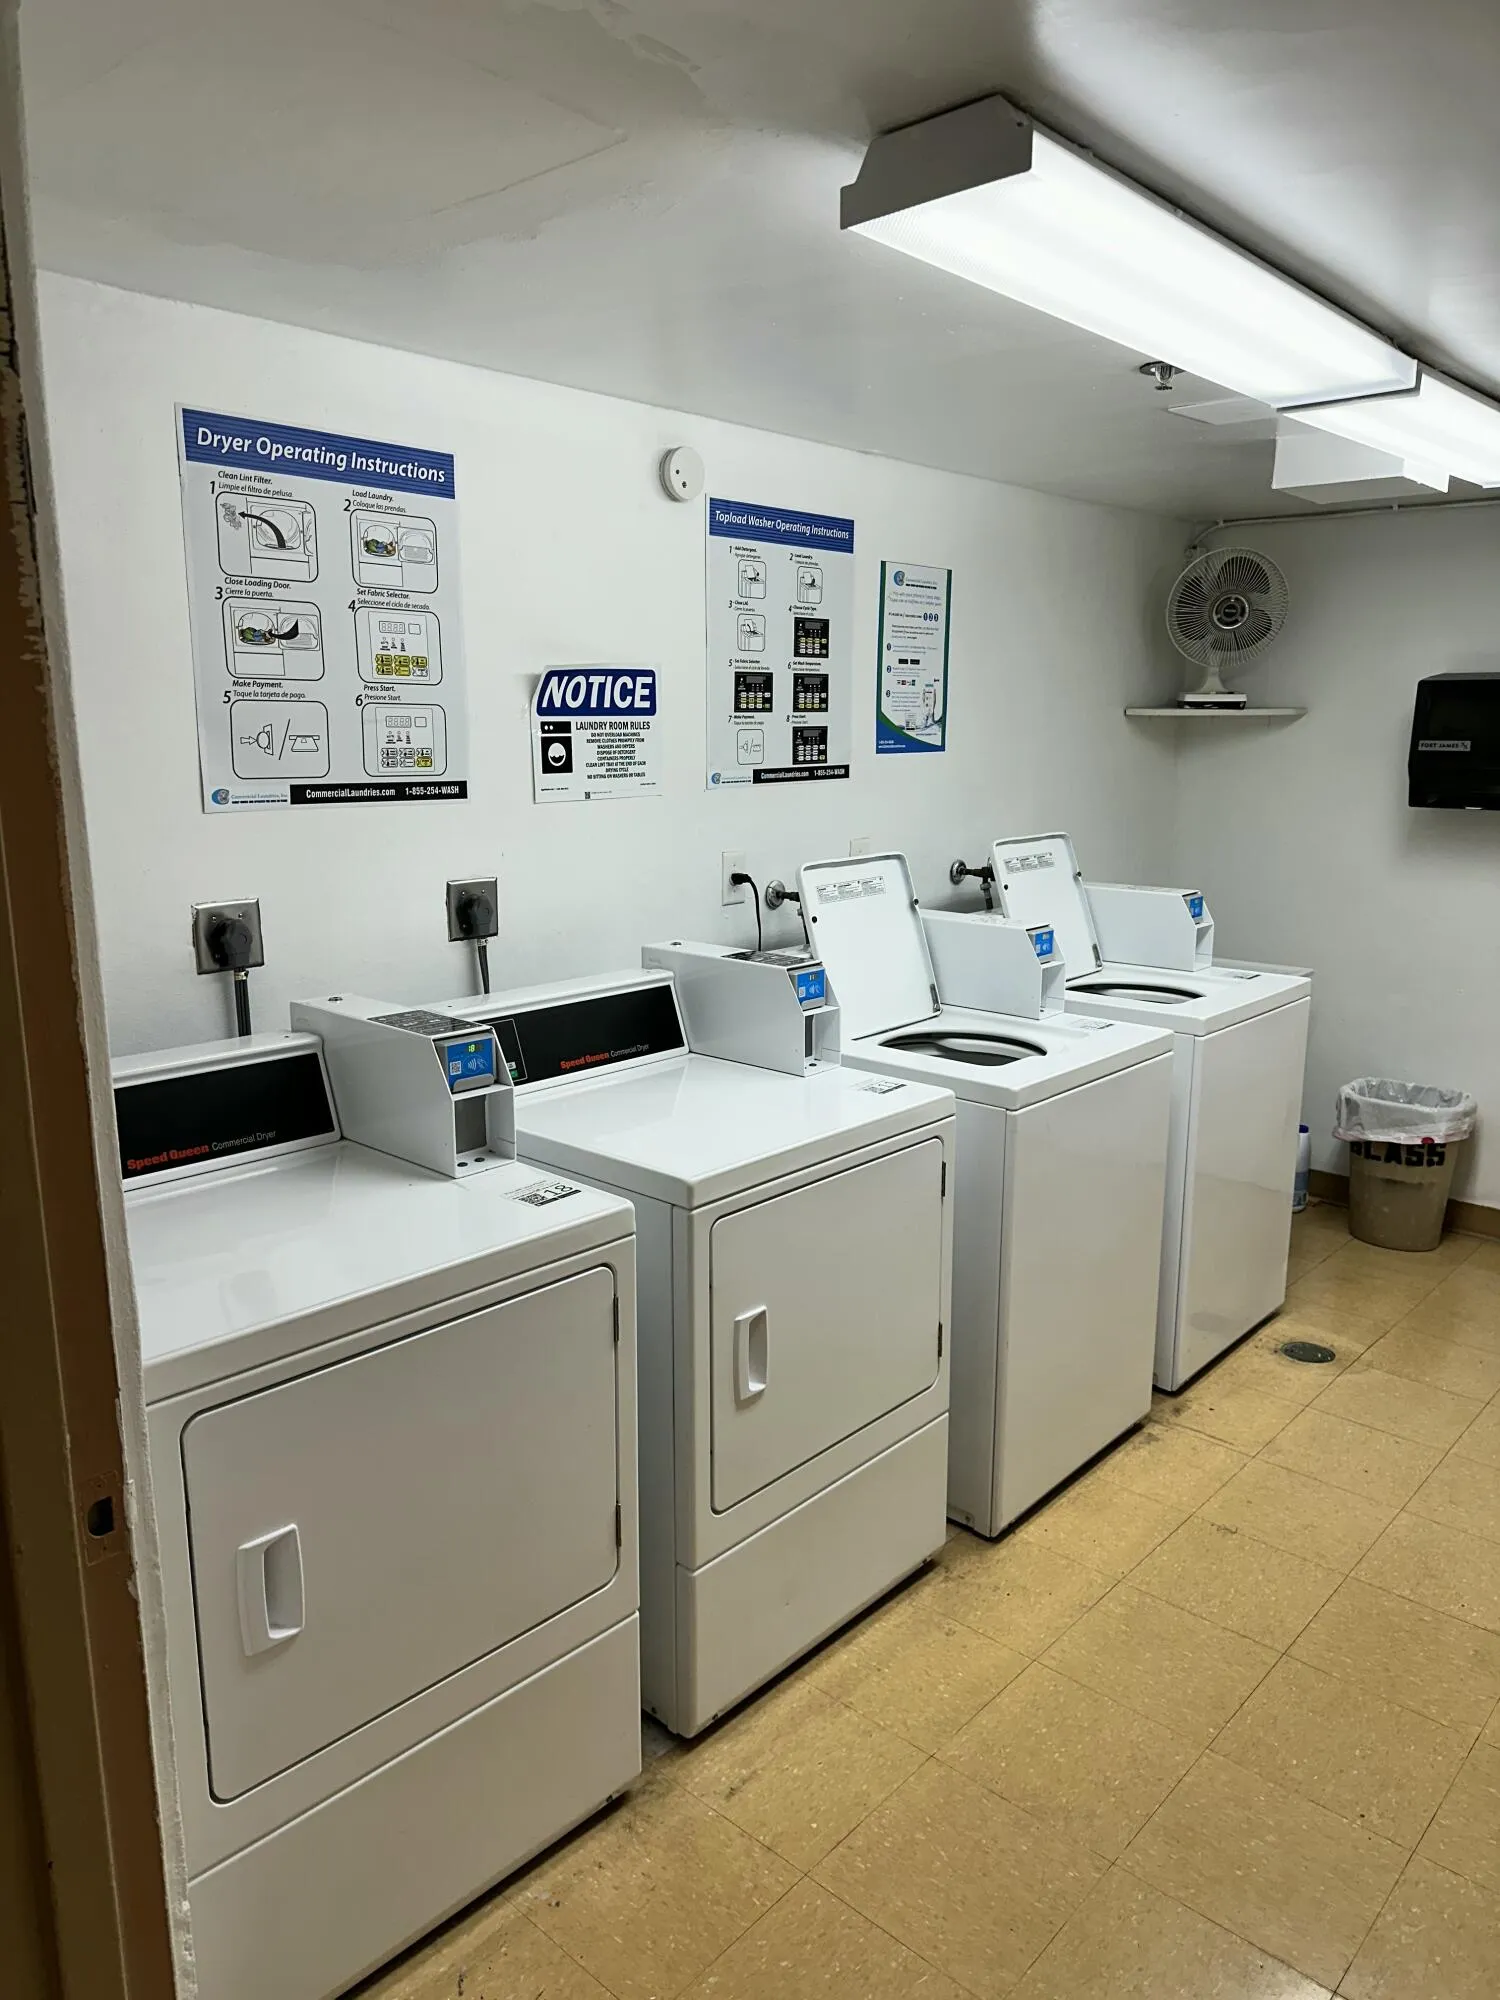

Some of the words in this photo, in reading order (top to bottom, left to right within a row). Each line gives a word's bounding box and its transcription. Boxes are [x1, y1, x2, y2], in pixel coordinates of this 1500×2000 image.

[197, 427, 252, 454] Dryer
[256, 437, 347, 471] Operating
[351, 452, 445, 482] Instructions
[218, 470, 238, 480] Clean
[240, 473, 252, 482] Lint
[254, 476, 273, 485] Filter.
[210, 481, 215, 494] 1
[219, 482, 240, 491] Limpie
[352, 490, 367, 498] Load
[368, 491, 393, 503] Laundry.
[344, 499, 351, 511] 2
[353, 500, 375, 509] Coloque
[376, 502, 384, 510] las
[716, 511, 746, 525] Topload
[748, 515, 774, 529] Washer
[776, 519, 810, 536] Operating
[811, 524, 849, 539] Instructions
[225, 577, 243, 585] Close
[245, 579, 272, 589] Loading
[273, 581, 291, 589] Door.
[215, 587, 223, 599] 3
[368, 589, 385, 597] Fabric
[386, 591, 410, 599] Selector.
[348, 600, 355, 612] 4
[358, 598, 385, 606] Seleccione
[253, 681, 283, 689] Payment.
[541, 675, 653, 708] NOTICE
[223, 691, 231, 703] 5
[234, 690, 252, 698] Toque
[260, 691, 280, 699] tarjeta
[356, 694, 363, 706] 6
[576, 722, 607, 730] LAUNDRY
[609, 722, 628, 730] ROOM
[630, 721, 651, 730] RULES
[306, 788, 396, 798] CommercialLaundries.com
[405, 786, 459, 795] 1-855-254-WASH
[560, 1056, 586, 1070] Speed
[586, 1052, 610, 1063] Queen
[610, 1046, 637, 1058] Commercial
[637, 1044, 650, 1052] Dryer
[127, 1151, 169, 1171] Speed
[170, 1144, 210, 1160] Queen
[212, 1135, 256, 1151] Commercial
[256, 1130, 276, 1141] Dryer
[544, 1185, 574, 1196] 18
